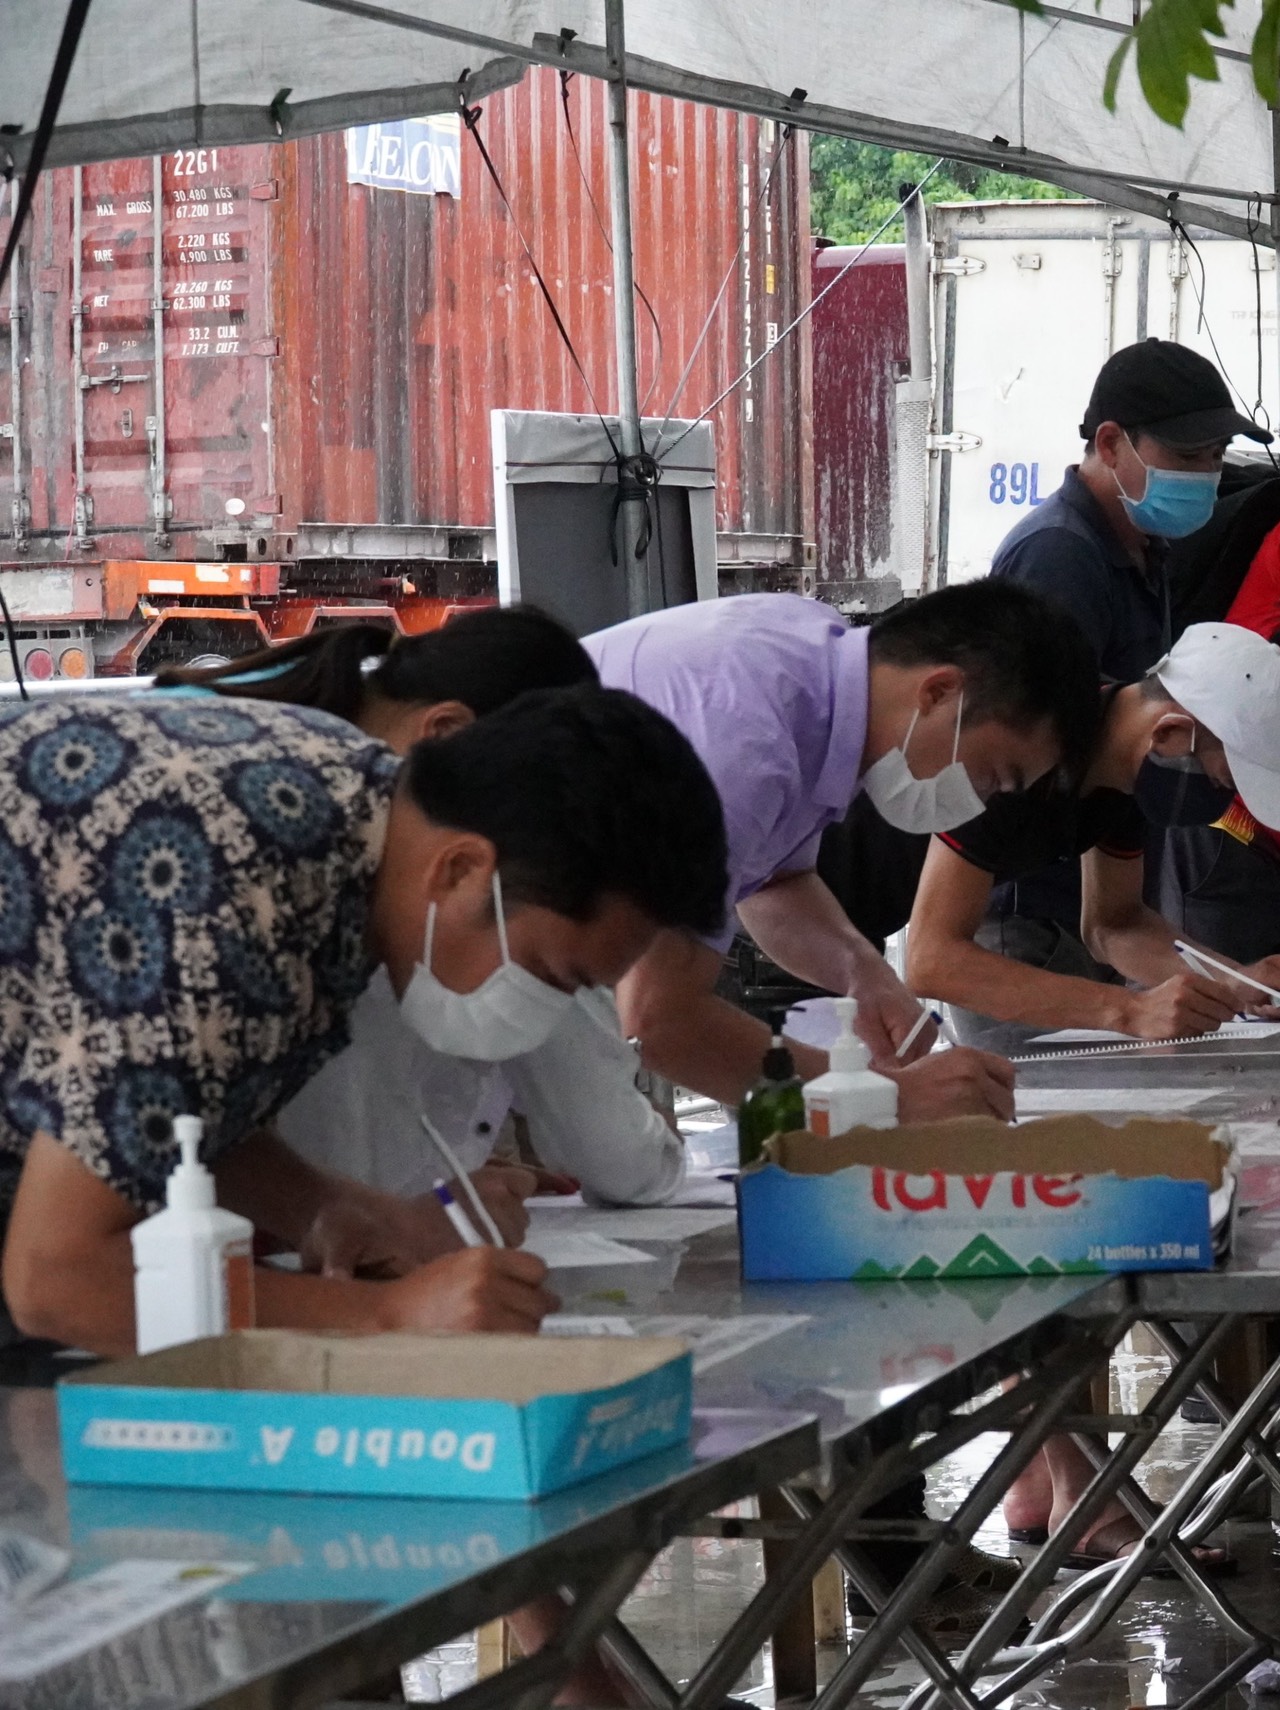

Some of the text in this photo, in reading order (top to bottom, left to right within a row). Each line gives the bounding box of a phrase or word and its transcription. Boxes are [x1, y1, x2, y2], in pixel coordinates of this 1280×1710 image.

[173, 149, 217, 176] 22G1
[173, 187, 232, 202] 30.480 KGS
[126, 201, 152, 214] GROSS
[176, 203, 234, 219] 67.200 LBS
[178, 233, 230, 249] 2.220 KGS
[94, 249, 114, 262] TARE
[180, 249, 232, 263] 4.900 LBS
[174, 280, 233, 295] 28.260 KGS
[94, 295, 109, 307] NET
[173, 295, 231, 310] 62.300 LBS
[189, 327, 210, 341] 33.2
[989, 462, 1048, 506] 89L
[1104, 1243, 1147, 1260] bottles
[260, 1425, 295, 1465] A
[314, 1426, 496, 1473] Double
